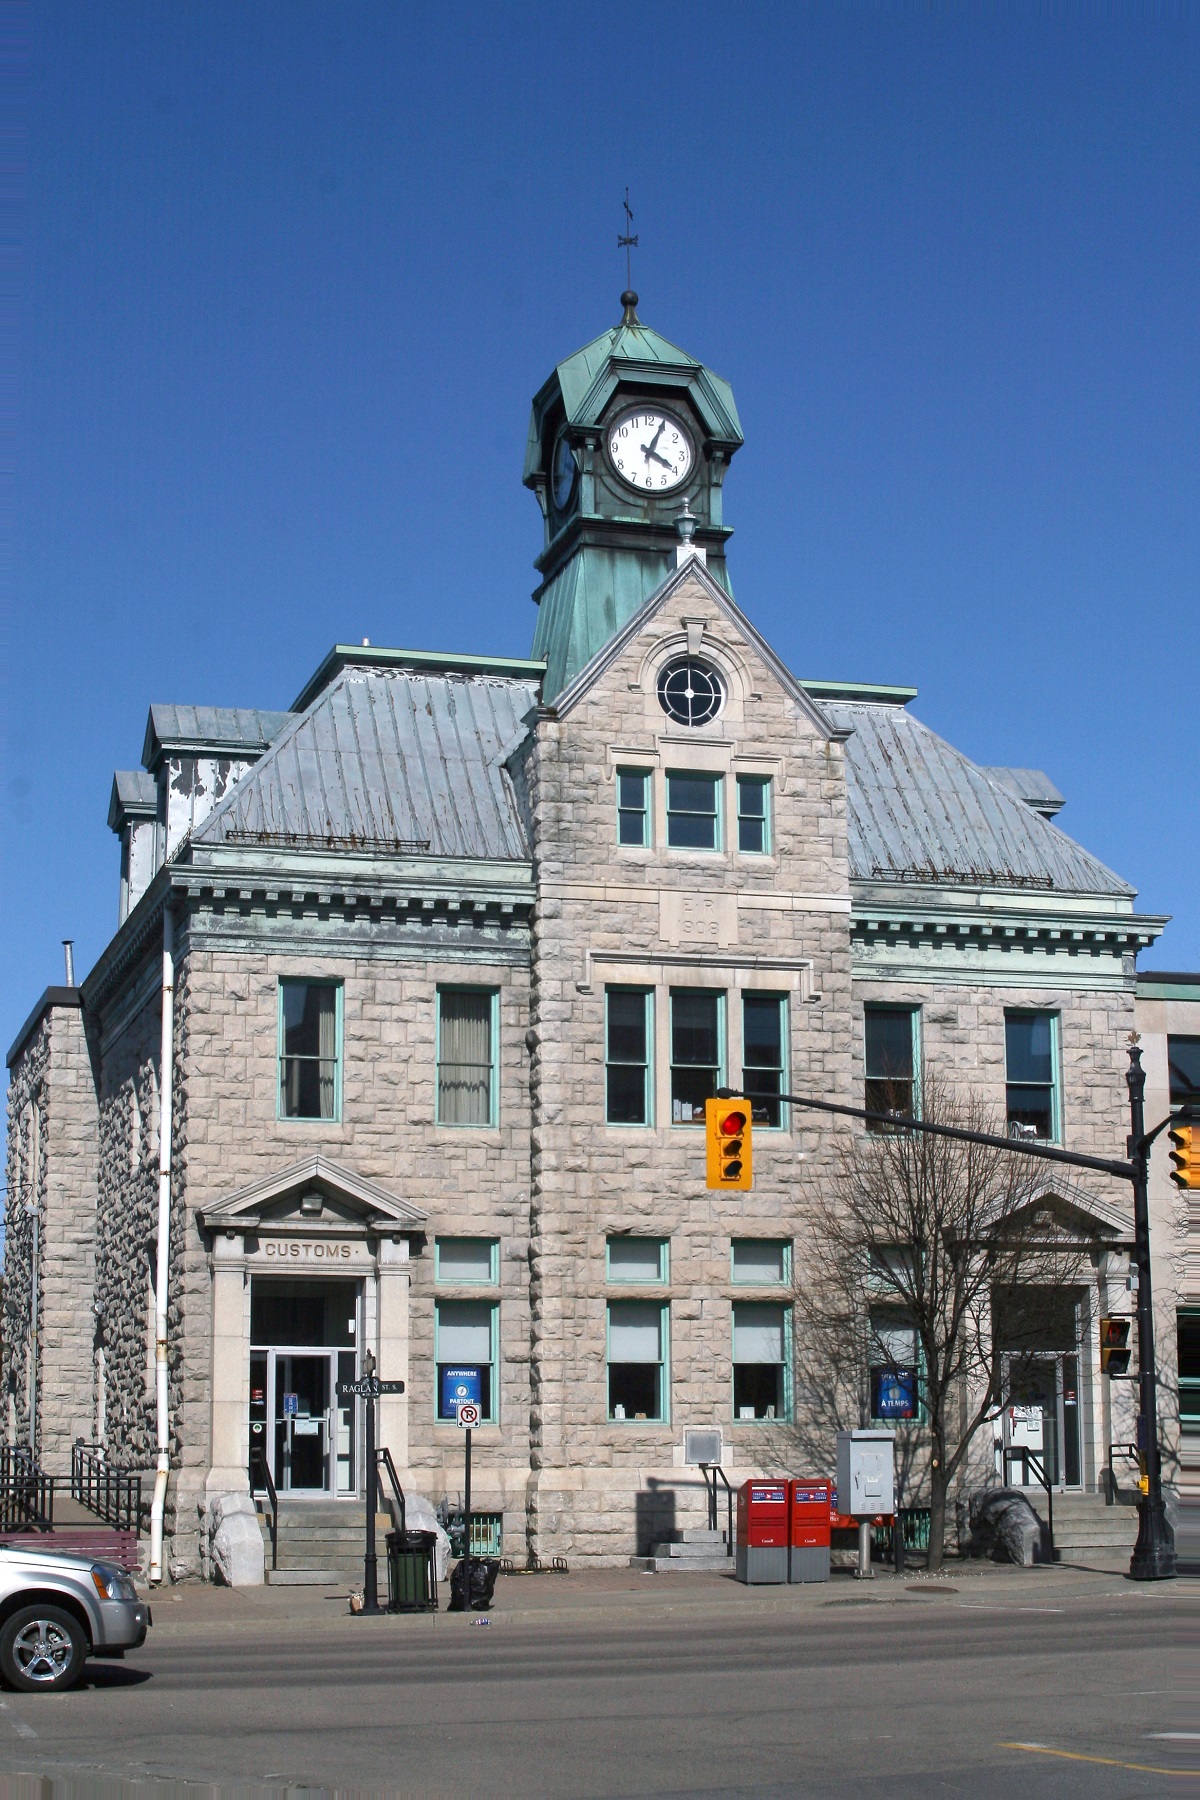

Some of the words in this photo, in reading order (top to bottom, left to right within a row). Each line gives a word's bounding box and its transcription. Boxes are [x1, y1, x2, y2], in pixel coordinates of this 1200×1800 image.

[631, 418, 639, 428] 11
[644, 415, 655, 426] 12
[618, 426, 628, 438] 10
[671, 432, 679, 444] 2
[611, 441, 619, 453] 9
[678, 450, 685, 462] 3
[617, 458, 624, 470] 8
[671, 465, 678, 476] 4
[631, 471, 637, 483] 7
[645, 476, 652, 488] 6
[660, 474, 667, 486] 5
[265, 1243, 351, 1258] CUSTOMS
[342, 1384, 378, 1393] RAGLAN
